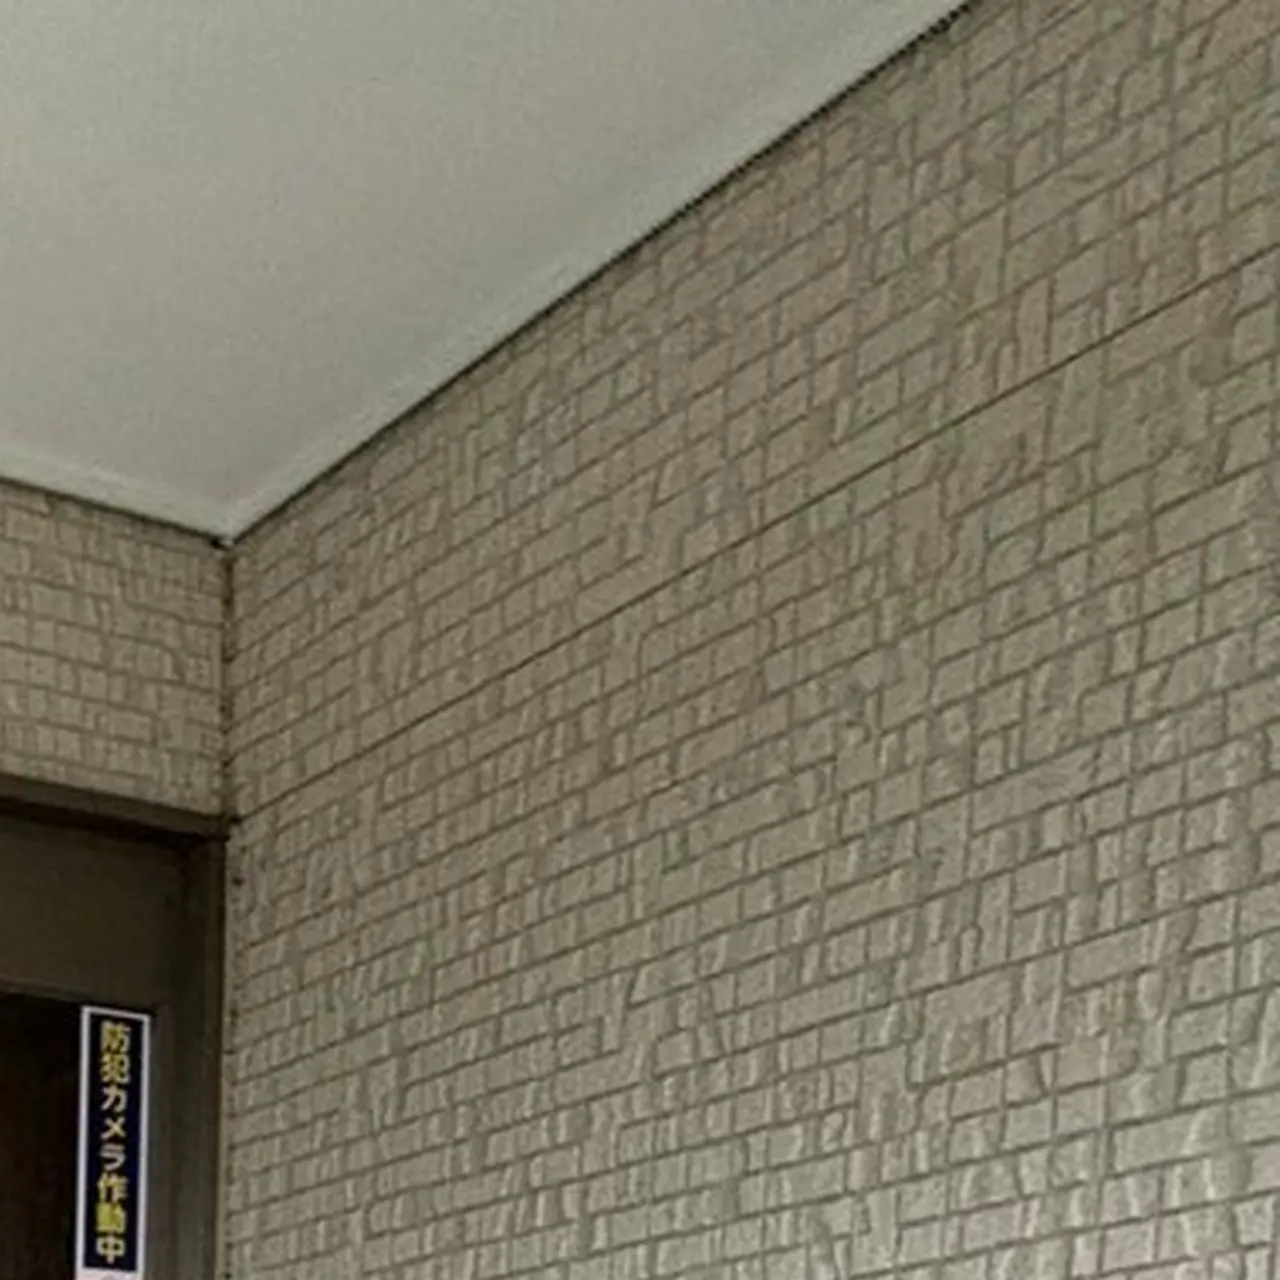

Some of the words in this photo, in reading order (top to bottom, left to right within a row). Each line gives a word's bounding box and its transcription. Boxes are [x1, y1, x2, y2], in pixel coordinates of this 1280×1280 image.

[95, 1020, 132, 1264] 防犯カメラ作動中
